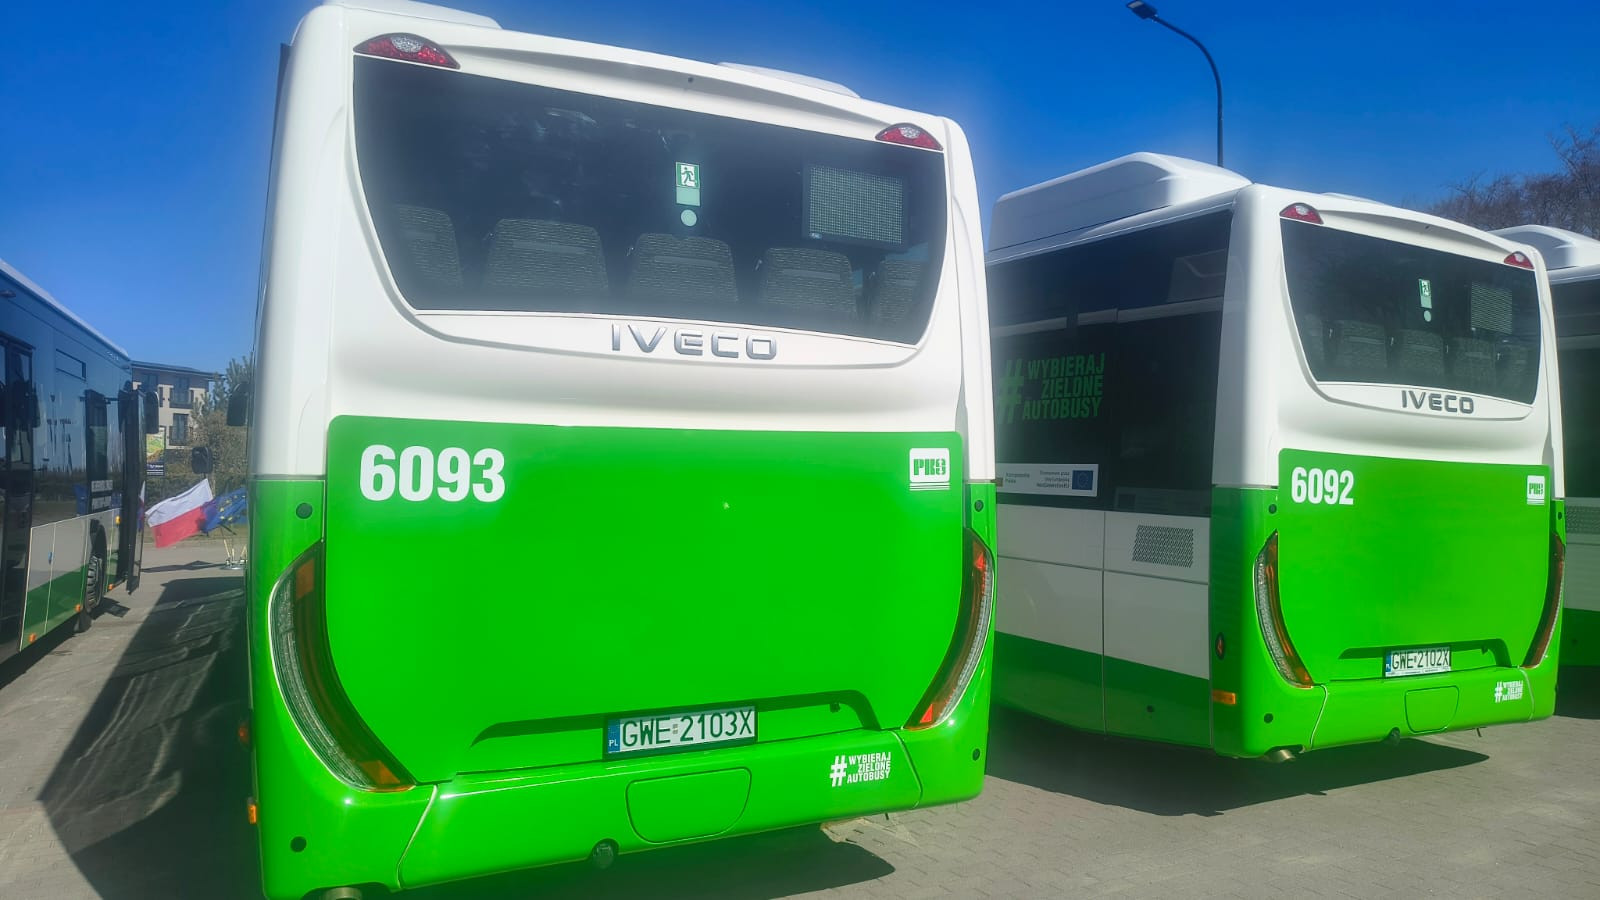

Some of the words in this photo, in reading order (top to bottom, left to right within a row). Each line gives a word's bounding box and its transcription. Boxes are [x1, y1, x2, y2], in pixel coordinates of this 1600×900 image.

[611, 323, 777, 360] IVECO
[1027, 352, 1105, 380] WYBIERAJ
[1041, 375, 1104, 400] ZIELONE
[1022, 397, 1102, 421] AUTOBUSY
[1401, 390, 1474, 413] IVECO
[359, 444, 506, 502] 6093
[913, 458, 946, 476] PKS
[1291, 466, 1354, 505] 6092
[1392, 650, 1414, 669] GWE
[1417, 648, 1449, 668] 2102X
[621, 716, 671, 747] GWE
[679, 708, 753, 742] 2103X
[608, 738, 619, 747] PL
[848, 751, 892, 765] WYBIERAJ
[857, 760, 892, 773] ZIELONE
[846, 767, 891, 784] AUTOBUSY
